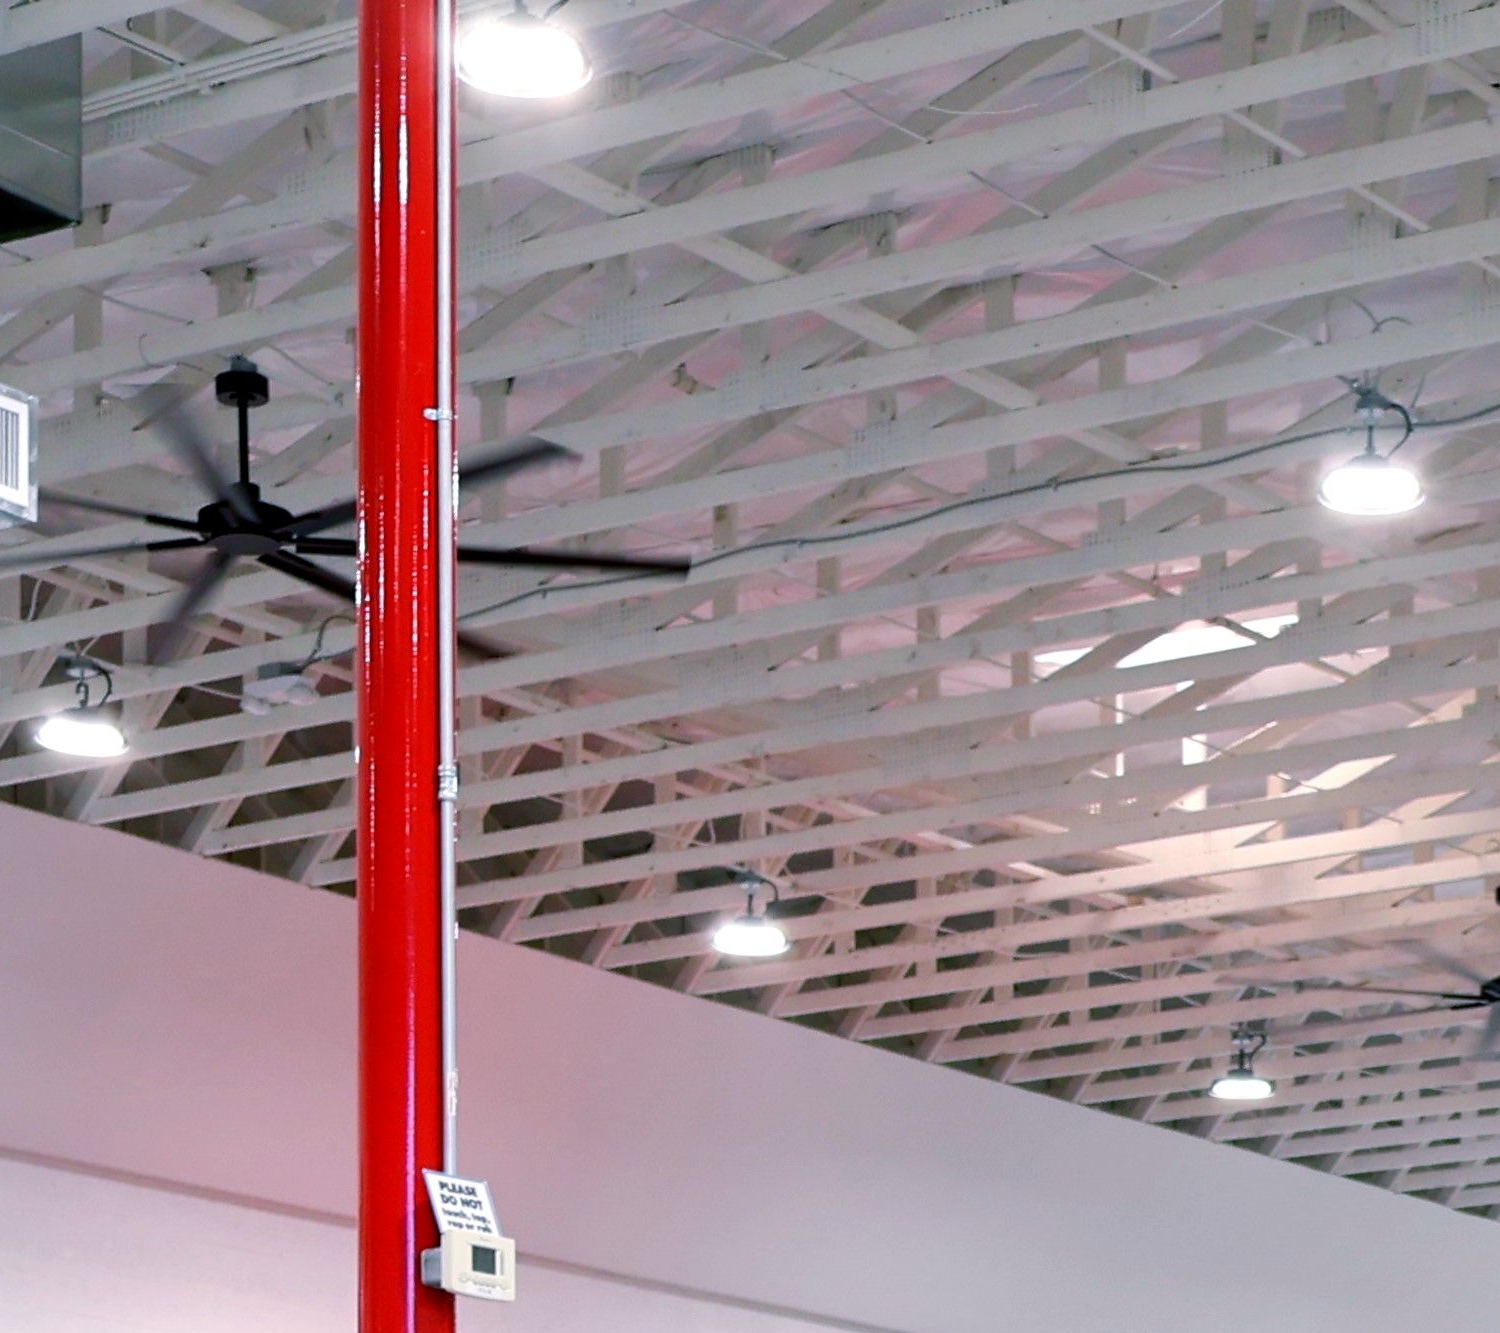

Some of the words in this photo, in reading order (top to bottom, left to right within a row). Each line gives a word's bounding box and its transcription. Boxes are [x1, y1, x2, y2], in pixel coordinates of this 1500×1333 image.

[438, 1180, 478, 1198] PLEASE
[440, 1193, 457, 1206] DO
[460, 1197, 483, 1211] NOT
